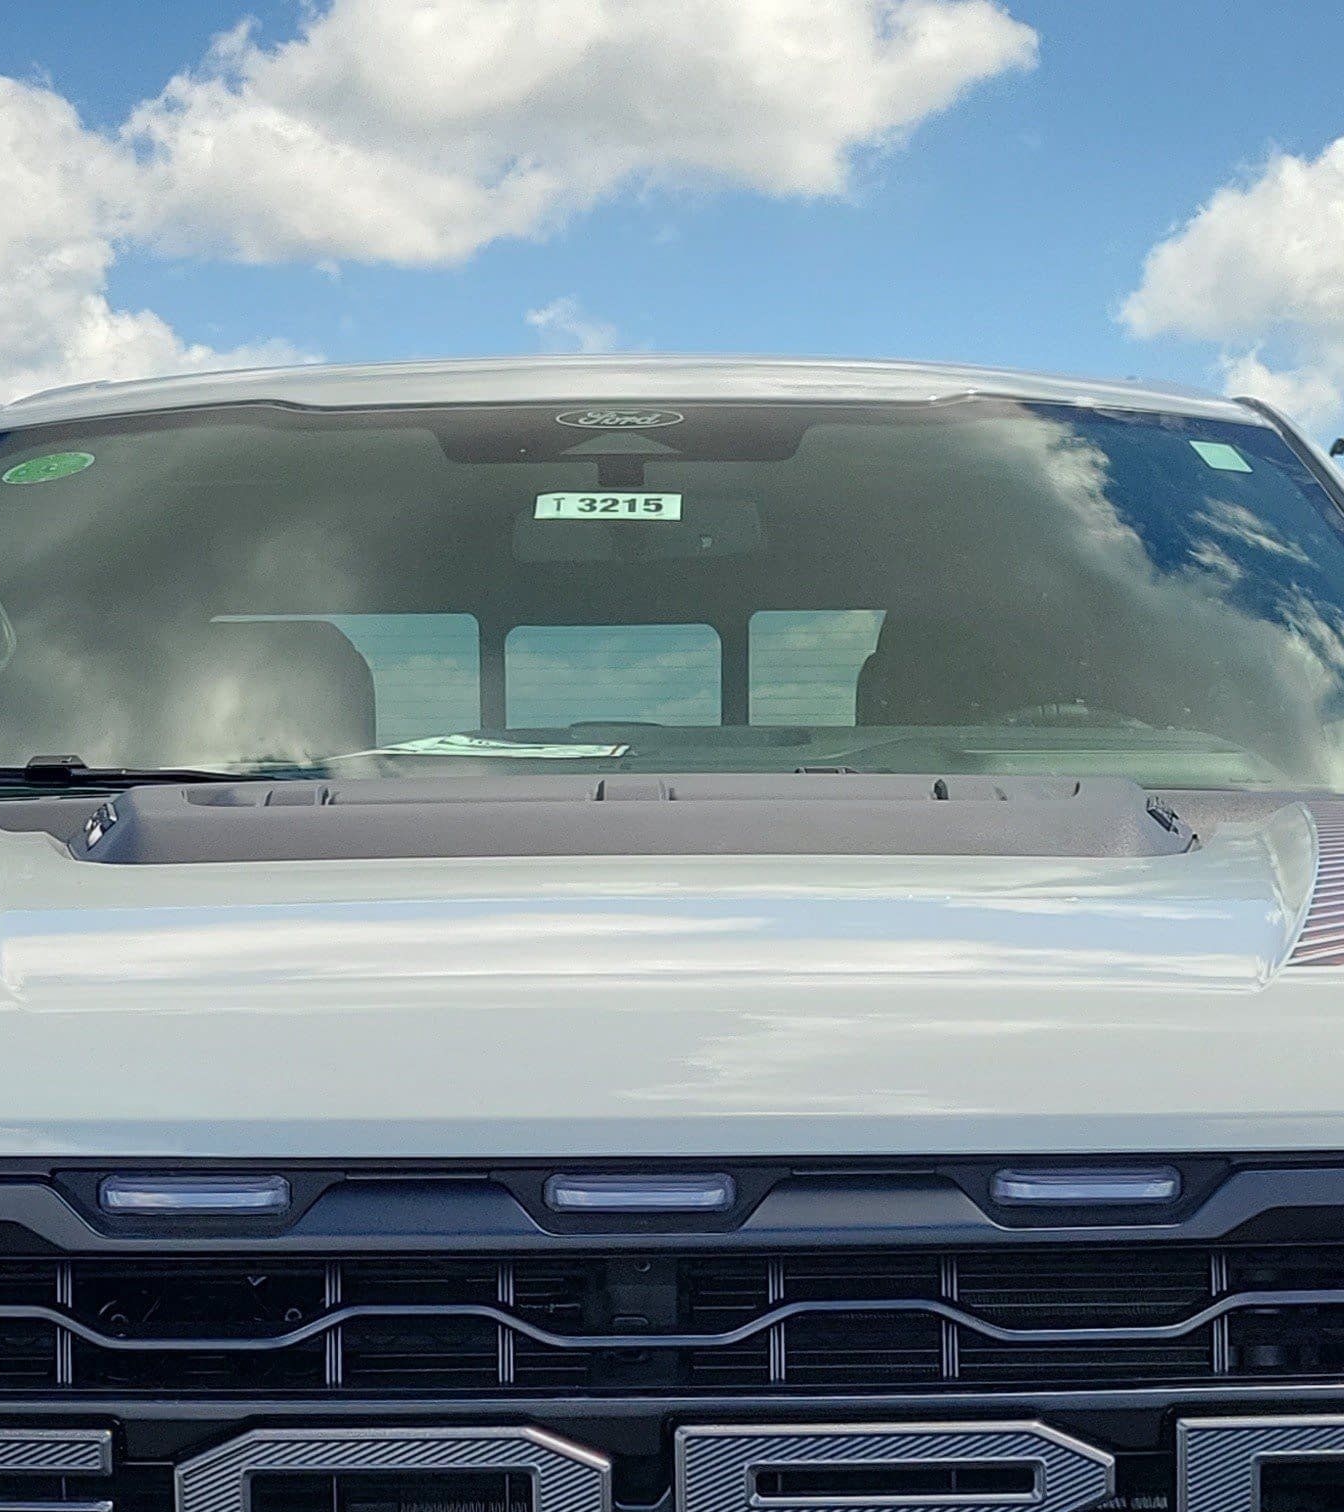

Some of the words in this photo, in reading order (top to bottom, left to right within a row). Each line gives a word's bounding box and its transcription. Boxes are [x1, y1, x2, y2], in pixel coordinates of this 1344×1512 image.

[578, 411, 661, 426] Ford
[553, 497, 566, 512] T
[577, 498, 664, 513] 3215
